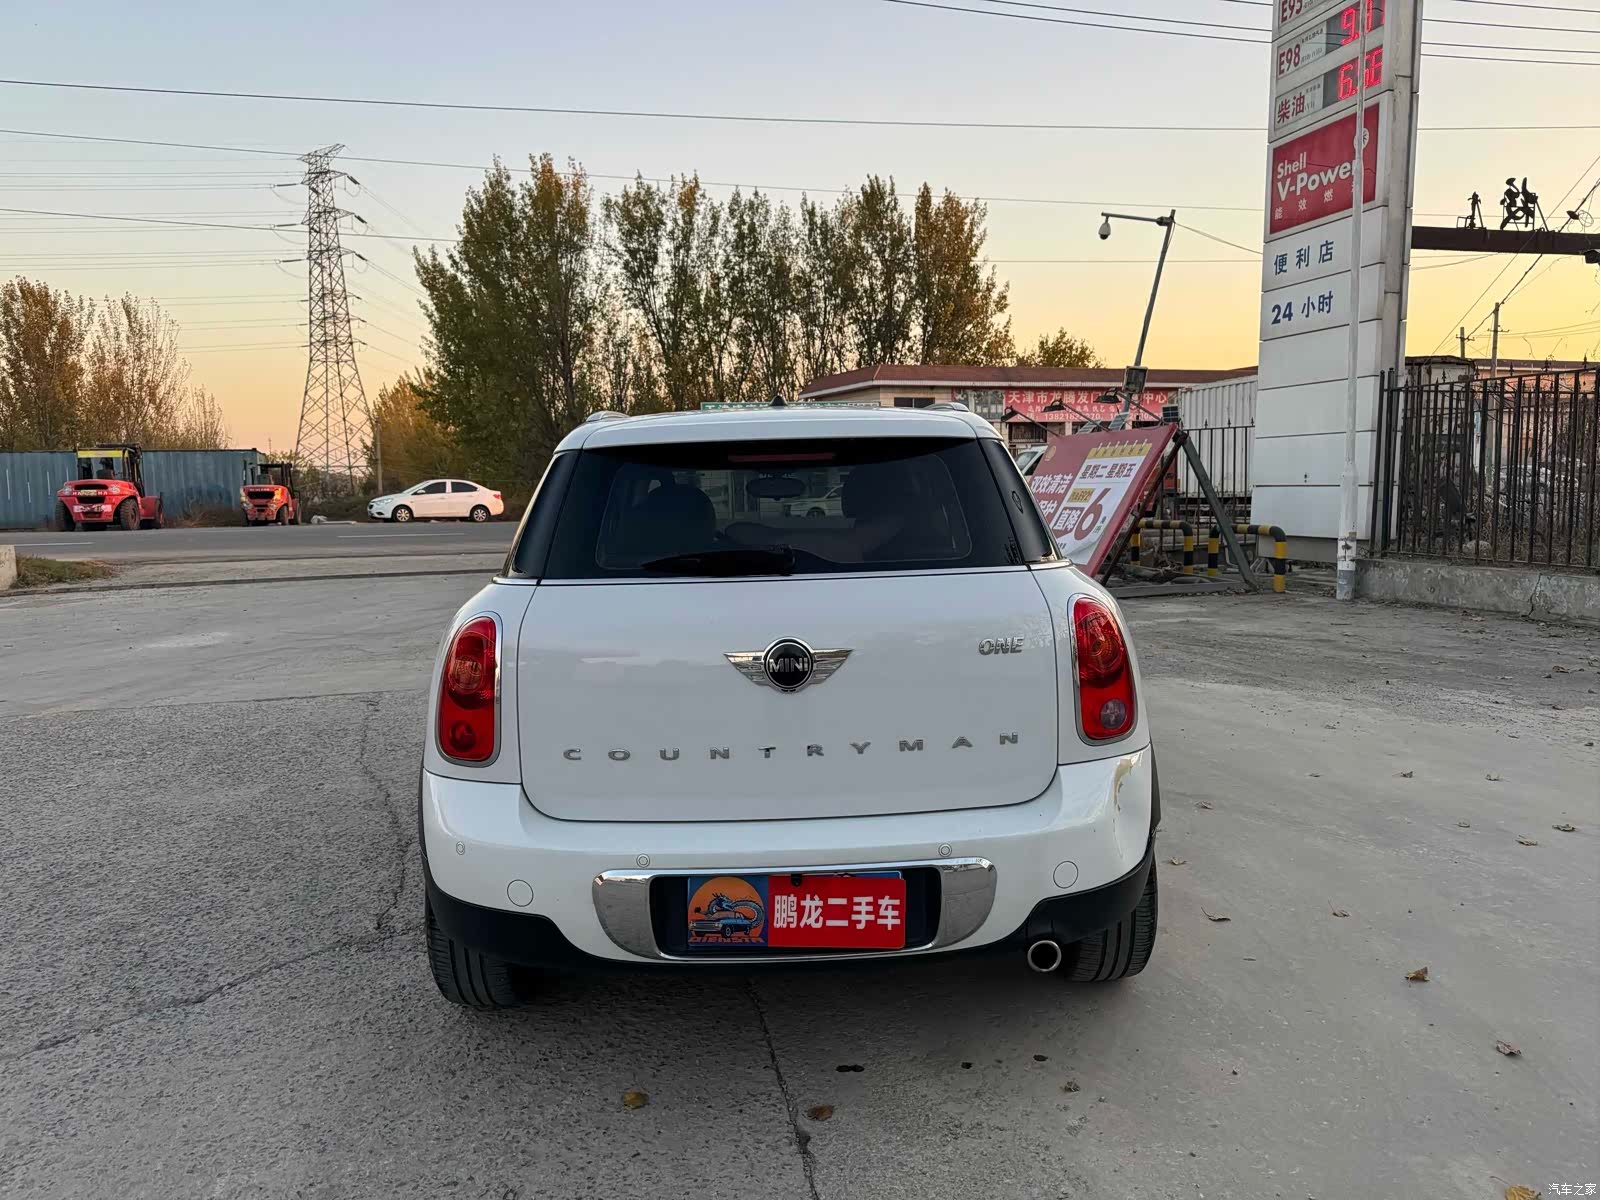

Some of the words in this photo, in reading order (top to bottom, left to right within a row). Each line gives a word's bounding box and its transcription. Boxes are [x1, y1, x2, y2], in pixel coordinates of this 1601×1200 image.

[1278, 43, 1301, 76] E98
[1276, 92, 1305, 124] 柴油
[1276, 151, 1307, 180] Shell
[1273, 239, 1335, 276] 便利店
[1271, 301, 1294, 326] 24
[1301, 290, 1334, 319] 小时
[1079, 464, 1108, 480] 星期二
[1105, 462, 1137, 479] 星期五
[1073, 487, 1112, 541] 6
[977, 635, 1025, 656] ONE
[768, 657, 809, 673] MINI
[562, 731, 1019, 762] COUNTRYMAN
[772, 893, 901, 931] 鹏龙二手车
